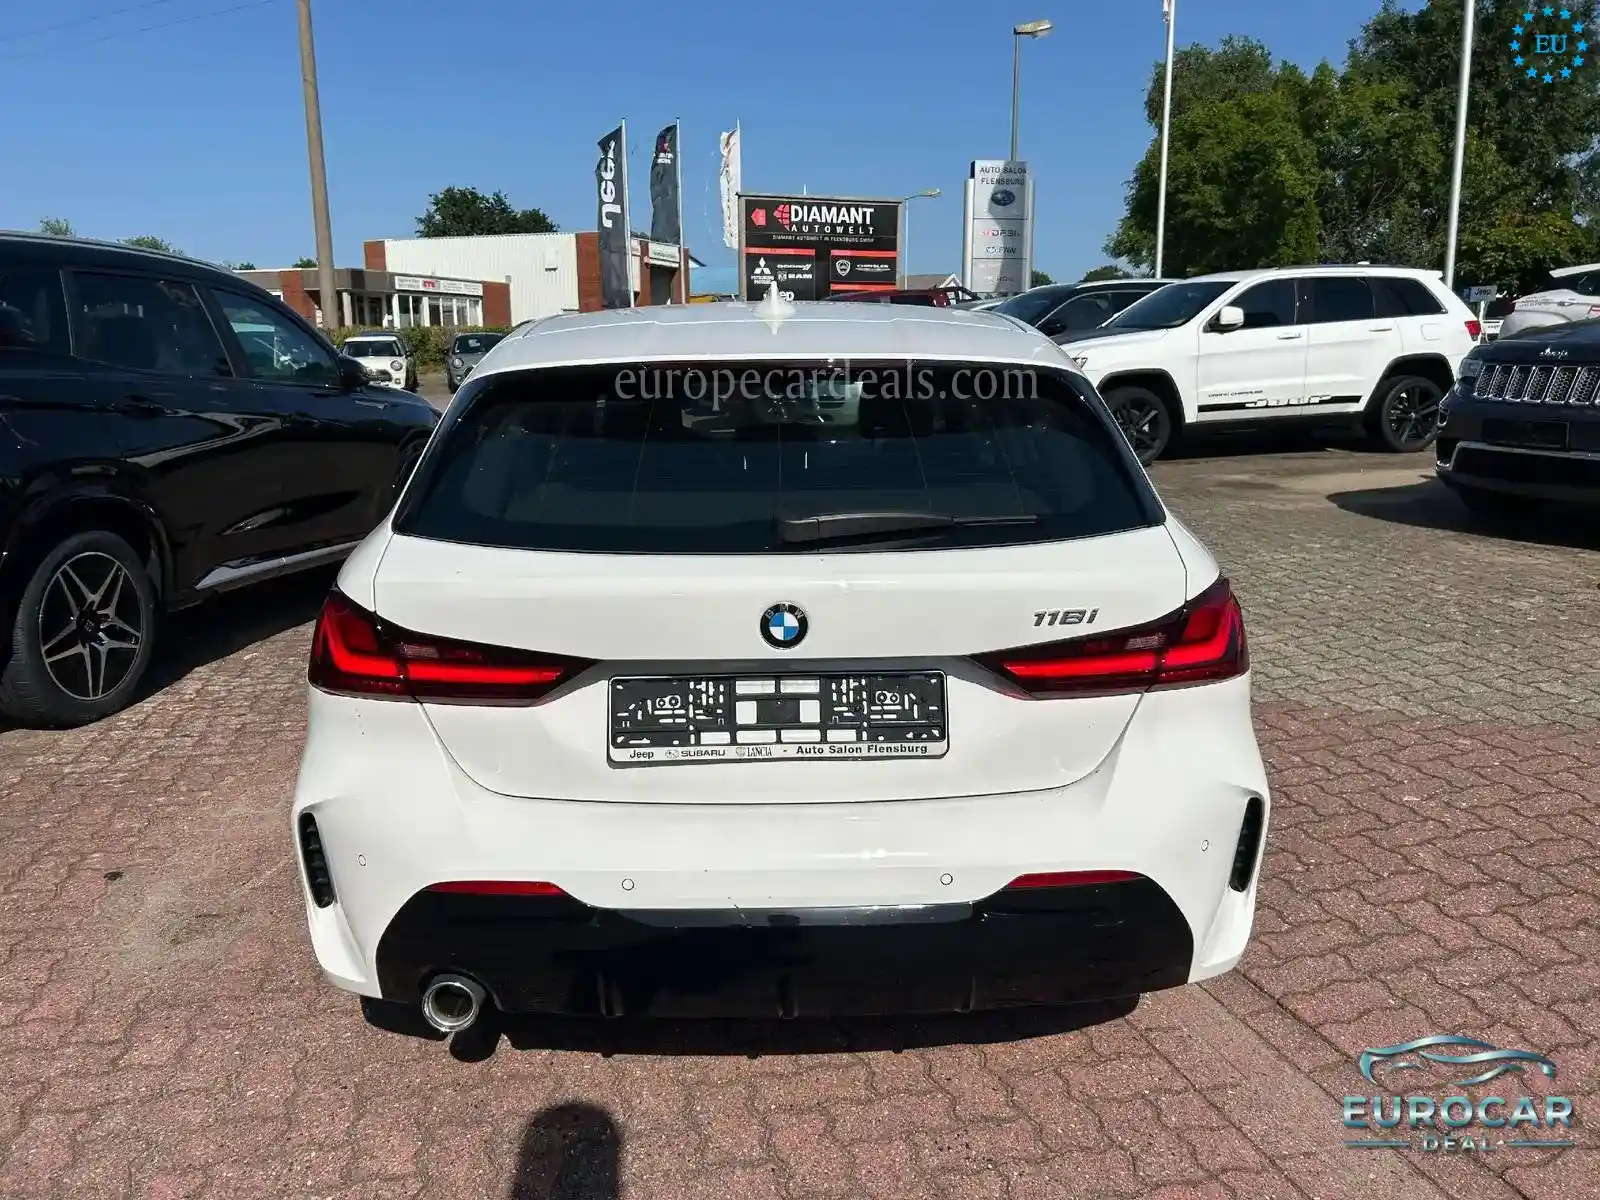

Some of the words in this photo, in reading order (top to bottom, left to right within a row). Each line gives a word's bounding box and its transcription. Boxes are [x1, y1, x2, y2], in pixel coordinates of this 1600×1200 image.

[790, 204, 875, 225] DIAMANT
[791, 224, 875, 235] AUTOWELT
[765, 603, 805, 619] BMW
[1033, 608, 1099, 627] 118i
[629, 749, 654, 760] Jeep
[681, 749, 726, 757] SUBARU
[747, 747, 772, 757] LANCIA
[796, 745, 824, 754] Auto
[828, 744, 863, 754] Salon
[867, 743, 928, 754] Flensburg
